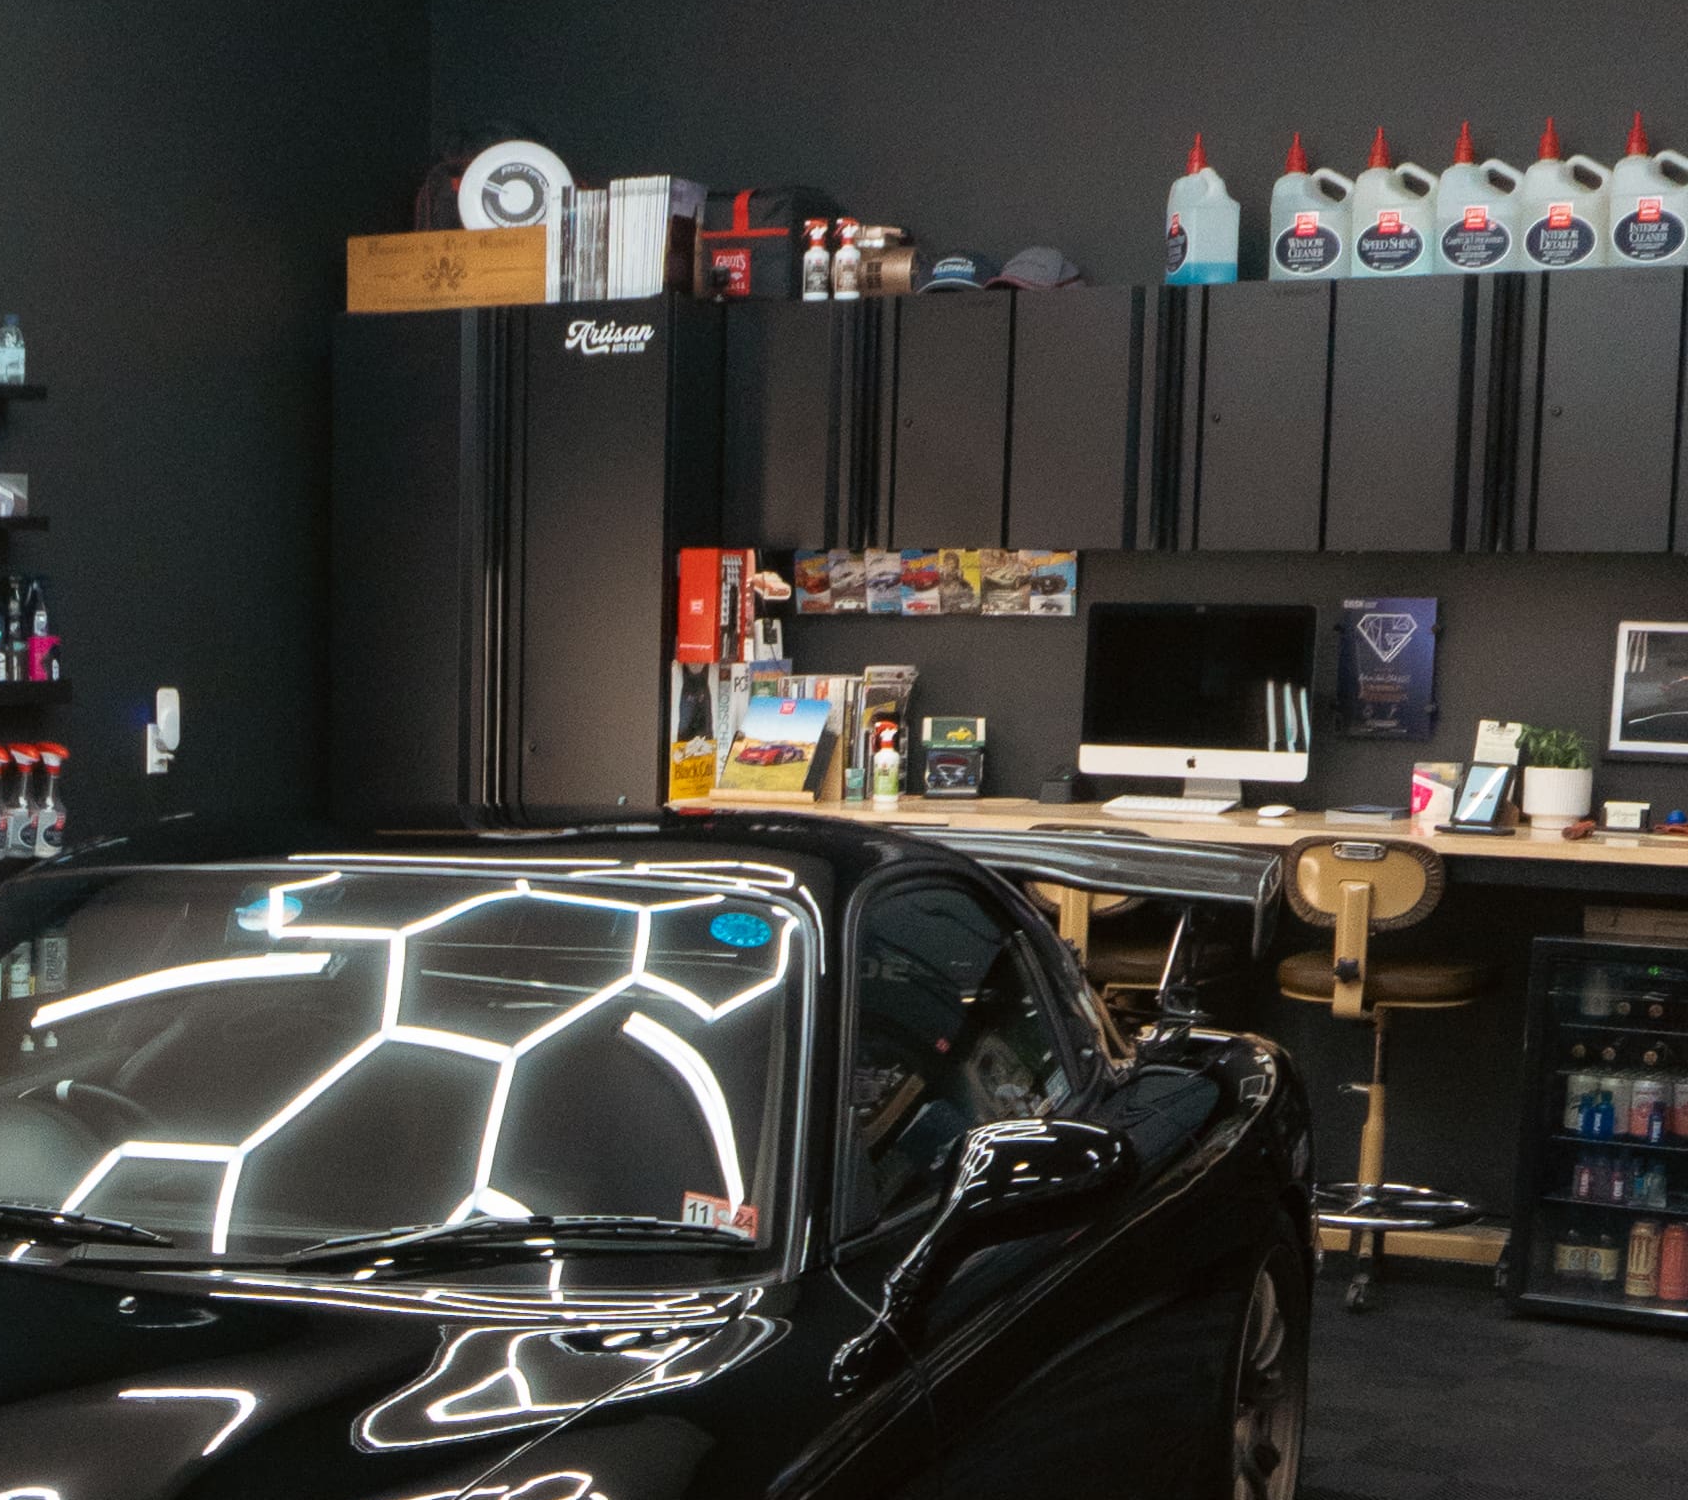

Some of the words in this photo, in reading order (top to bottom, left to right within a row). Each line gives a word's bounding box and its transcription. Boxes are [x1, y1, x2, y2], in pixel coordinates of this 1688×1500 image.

[1288, 247, 1324, 258] CLEANER
[565, 320, 655, 355] Artisan
[687, 1201, 710, 1224] 11
